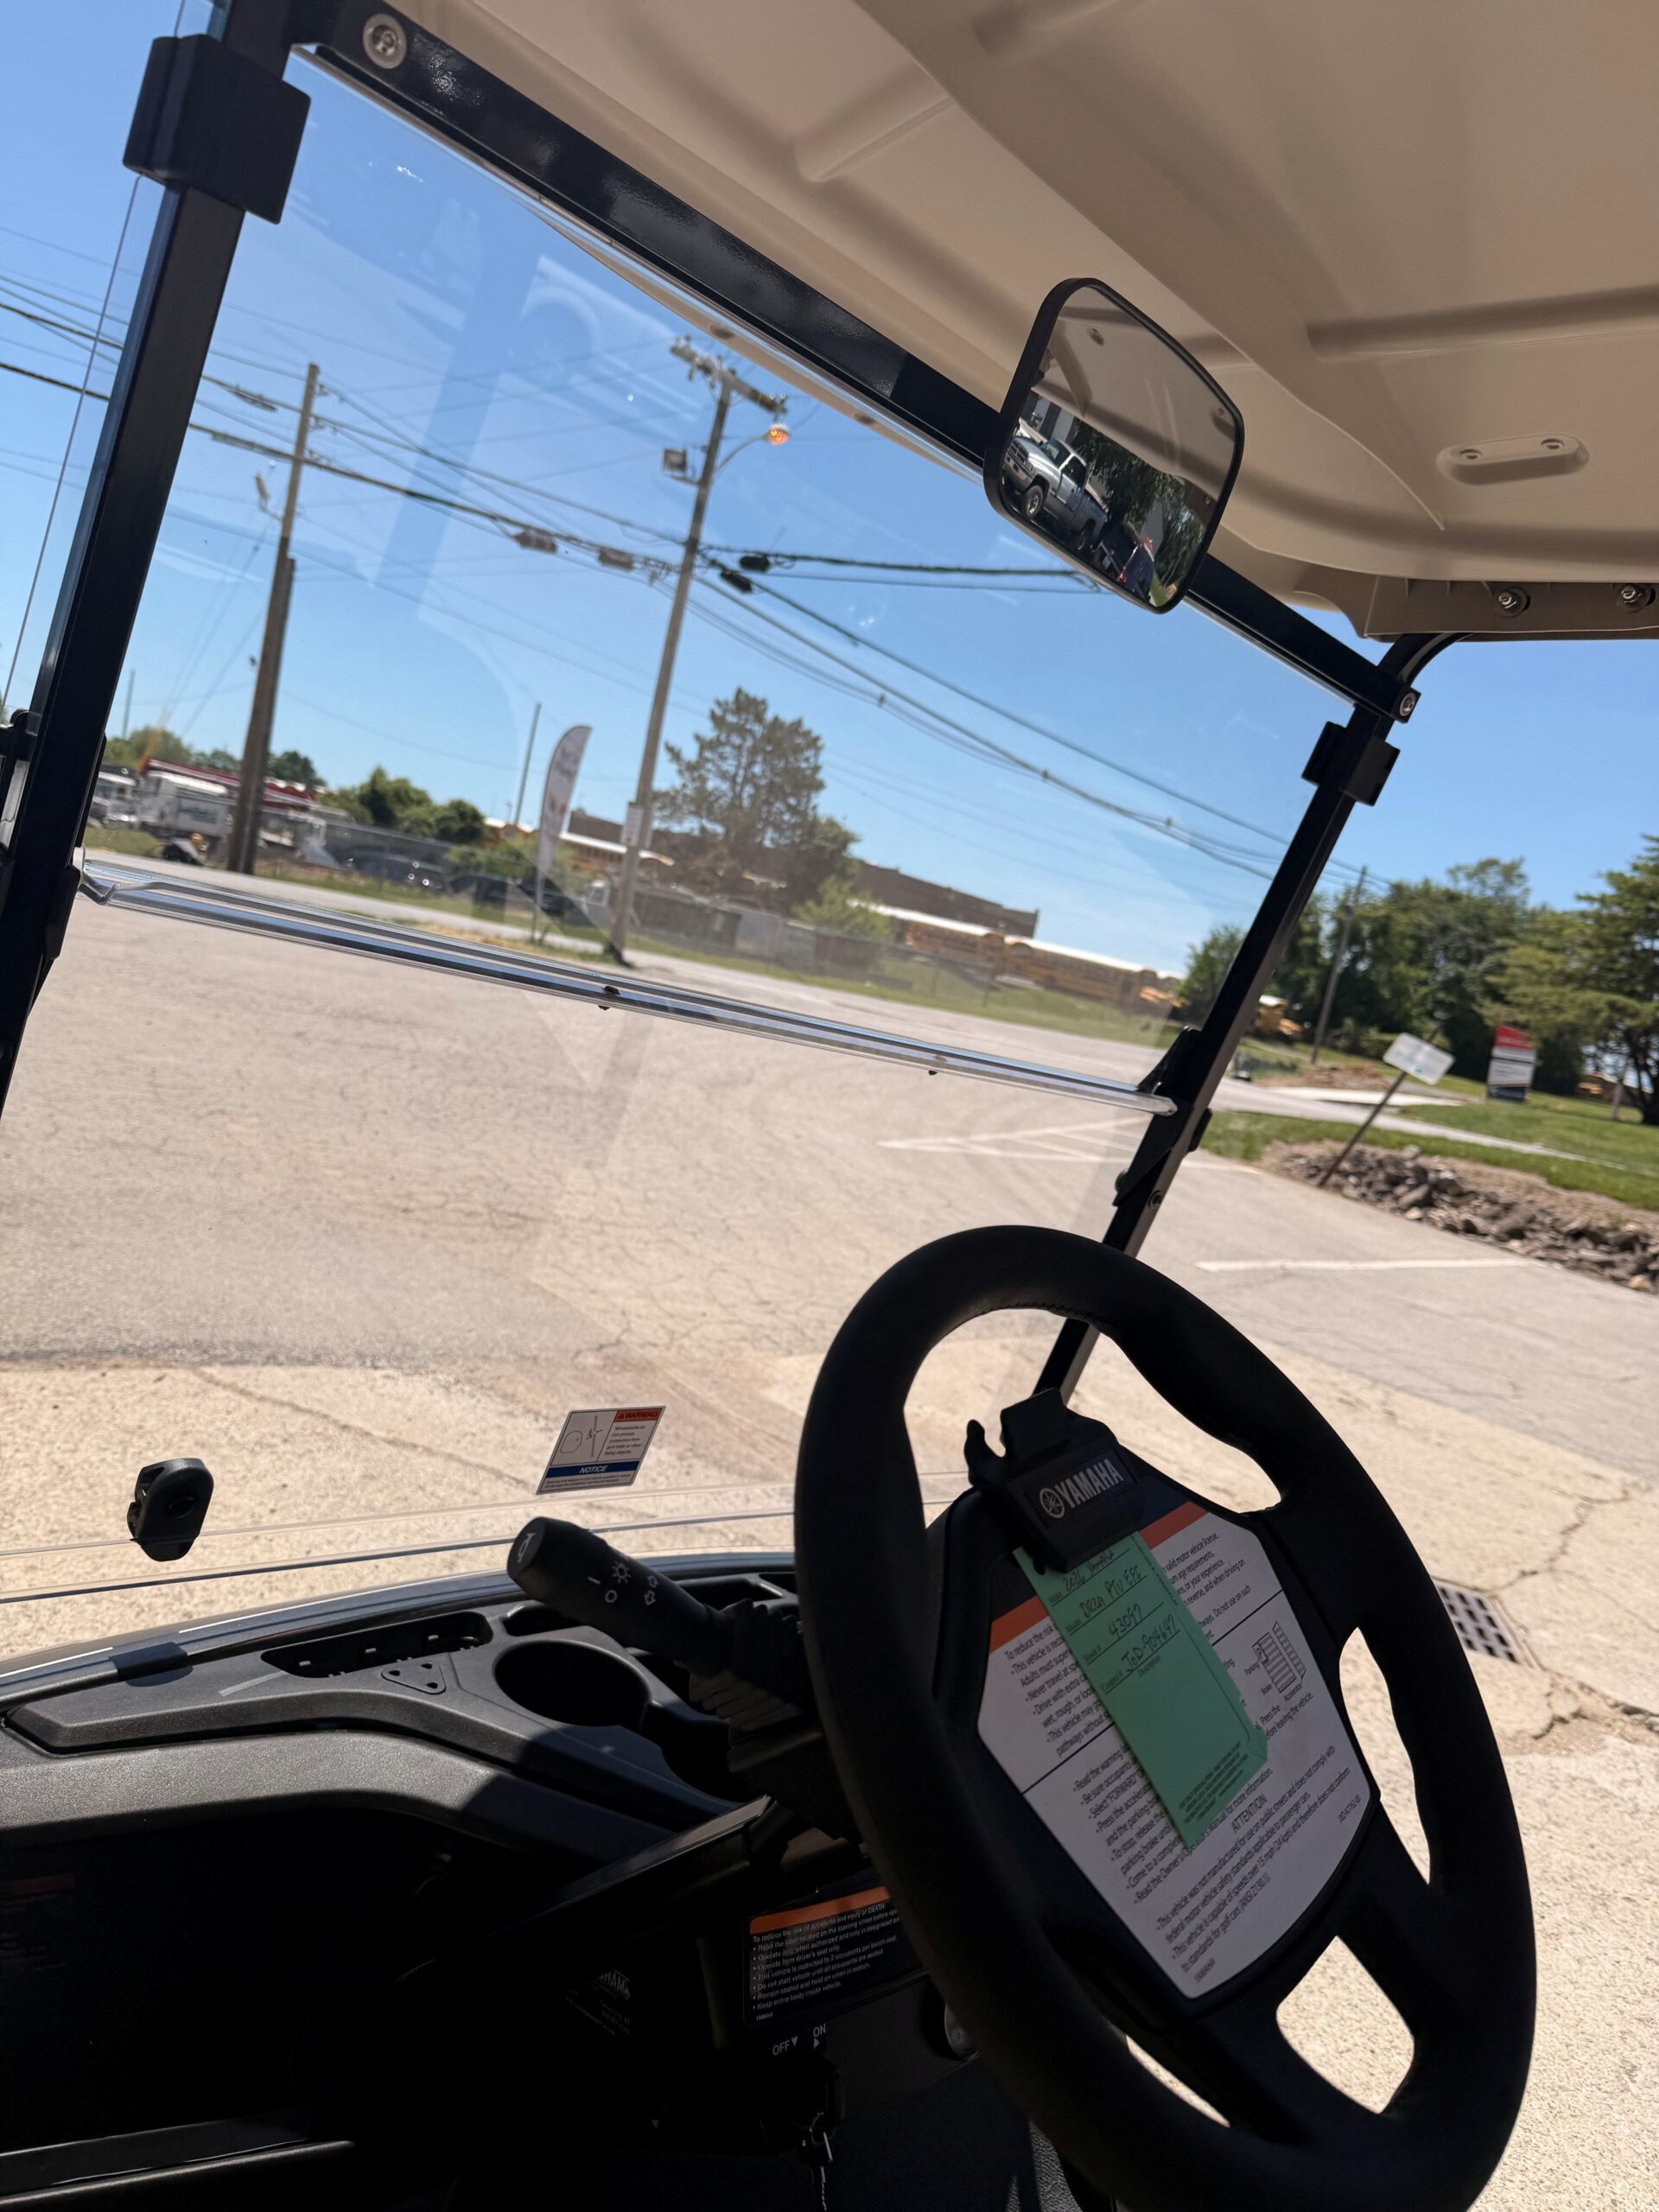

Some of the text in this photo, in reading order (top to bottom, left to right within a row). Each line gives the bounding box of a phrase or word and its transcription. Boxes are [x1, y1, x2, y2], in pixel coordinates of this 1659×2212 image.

[623, 1410, 659, 1419] WARNING
[578, 1465, 608, 1474] NOTICE
[1055, 1459, 1123, 1509] YAMAHA
[1163, 1529, 1219, 1571] valid motor vehicle license.
[1176, 1548, 1216, 1581] age requirements.
[1185, 1587, 1206, 1605] reverse,
[1201, 1579, 1214, 1592] and
[1210, 1570, 1226, 1586] when
[1222, 1560, 1242, 1580] driving
[1189, 1573, 1203, 1588] your
[1198, 1555, 1226, 1580] experience.
[1219, 1600, 1230, 1612] not
[1227, 1595, 1237, 1607] use
[1238, 1582, 1252, 1597] such
[1011, 1635, 1035, 1656] reduce
[1031, 1629, 1045, 1643] the
[1040, 1623, 1055, 1637] risk
[1010, 1657, 1027, 1675] This
[1023, 1644, 1047, 1667] vehicle
[1018, 1657, 1055, 1688] Adults must
[1026, 1681, 1047, 1701] Never
[1043, 1669, 1065, 1689] travel
[1046, 1704, 1096, 1742] This vehicle may
[1259, 1701, 1281, 1726] Press the
[1073, 1748, 1124, 1791] Read the warning
[1090, 1782, 1105, 1798] sure
[1102, 1759, 1134, 1789] occupants
[1088, 1796, 1109, 1819] Select
[1096, 1811, 1116, 1833] Press
[1111, 1802, 1125, 1820] the
[1229, 1791, 1268, 1834] ATTENTION
[1119, 1834, 1138, 1856] stop,
[1133, 1816, 1156, 1840] release
[1152, 1808, 1166, 1824] the
[1156, 1910, 1172, 1930] This
[1167, 1891, 1191, 1918] vehicle
[1186, 1884, 1200, 1900] was
[1196, 1874, 1209, 1891] not
[1204, 1833, 1248, 1881] manufactured
[1236, 1833, 1248, 1848] for
[1244, 1827, 1255, 1840] use
[1257, 1805, 1275, 1827] public
[1271, 1792, 1289, 1813] streets
[1285, 1783, 1297, 1799] and
[1293, 1772, 1307, 1790] does
[1303, 1766, 1314, 1780] not
[1310, 1751, 1328, 1775] comply
[1324, 1743, 1337, 1759] with
[1126, 1864, 1147, 1889] Come
[1164, 1917, 1186, 1945] federal
[1183, 1904, 1202, 1926] motor
[1198, 1883, 1220, 1910] vehicle
[1215, 1869, 1234, 1892] safety
[1228, 1847, 1255, 1877] standards
[1250, 1823, 1278, 1855] applicable
[1278, 1799, 1303, 1828] passenger
[1299, 1789, 1312, 1805] cars.
[1172, 1938, 1188, 1959] This
[1183, 1918, 1206, 1947] vehicle
[1205, 1894, 1230, 1925] capable
[1230, 1872, 1250, 1898] speeds
[1246, 1863, 1261, 1880] over
[1262, 1844, 1277, 1864] mph
[1272, 1836, 1284, 1852] (24
[1279, 1826, 1294, 1846] kph)
[1289, 1817, 1301, 1834] and
[1297, 1798, 1319, 1825] therefore
[1315, 1788, 1329, 1805] does
[1325, 1782, 1336, 1796] not
[1331, 1764, 1351, 1788] conform
[1135, 1880, 1154, 1903] Read
[1148, 1871, 1163, 1889] the
[1185, 1932, 1215, 1967] standards
[1210, 1923, 1223, 1941] for
[1217, 1912, 1234, 1935] golf
[1229, 1904, 1242, 1922] cars
[772, 2038, 791, 2056] OFF
[812, 2023, 827, 2038] ON
